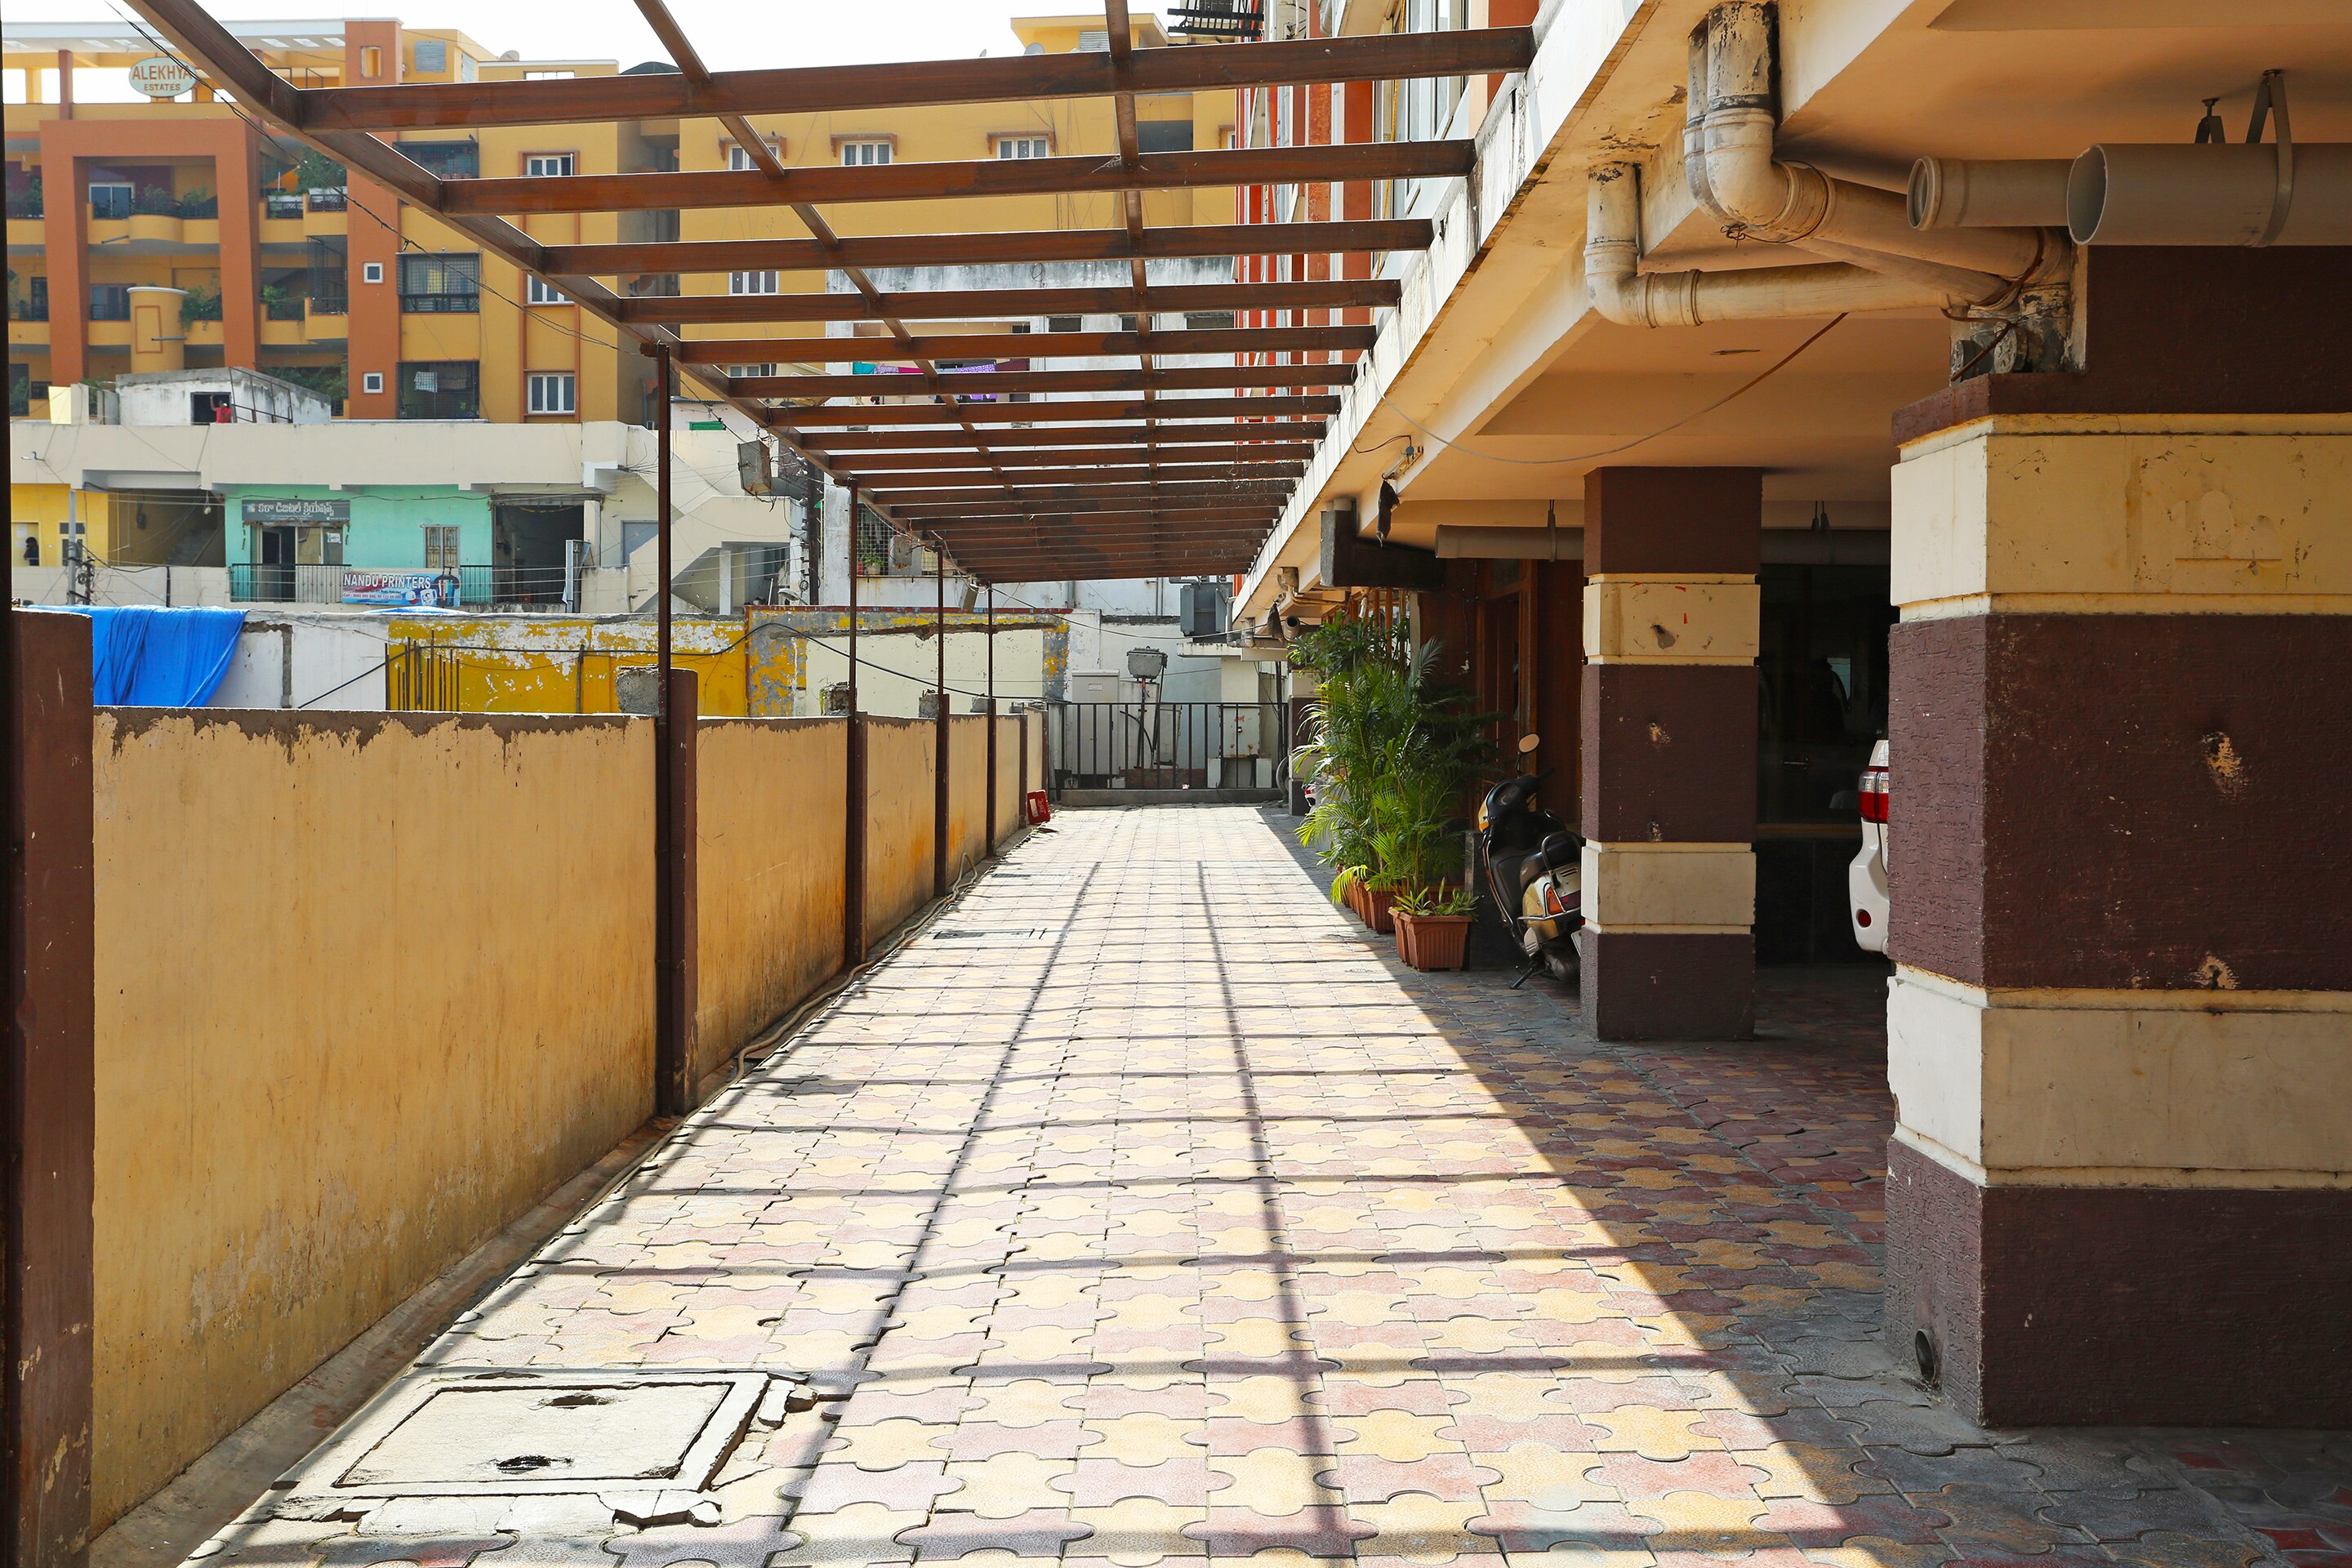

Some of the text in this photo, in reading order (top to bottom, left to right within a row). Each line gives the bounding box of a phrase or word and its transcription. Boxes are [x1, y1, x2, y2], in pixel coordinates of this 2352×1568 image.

[131, 65, 193, 80] ALEKHYA
[144, 83, 180, 91] ESTATES
[344, 573, 431, 589] NANDU PRINTERS
